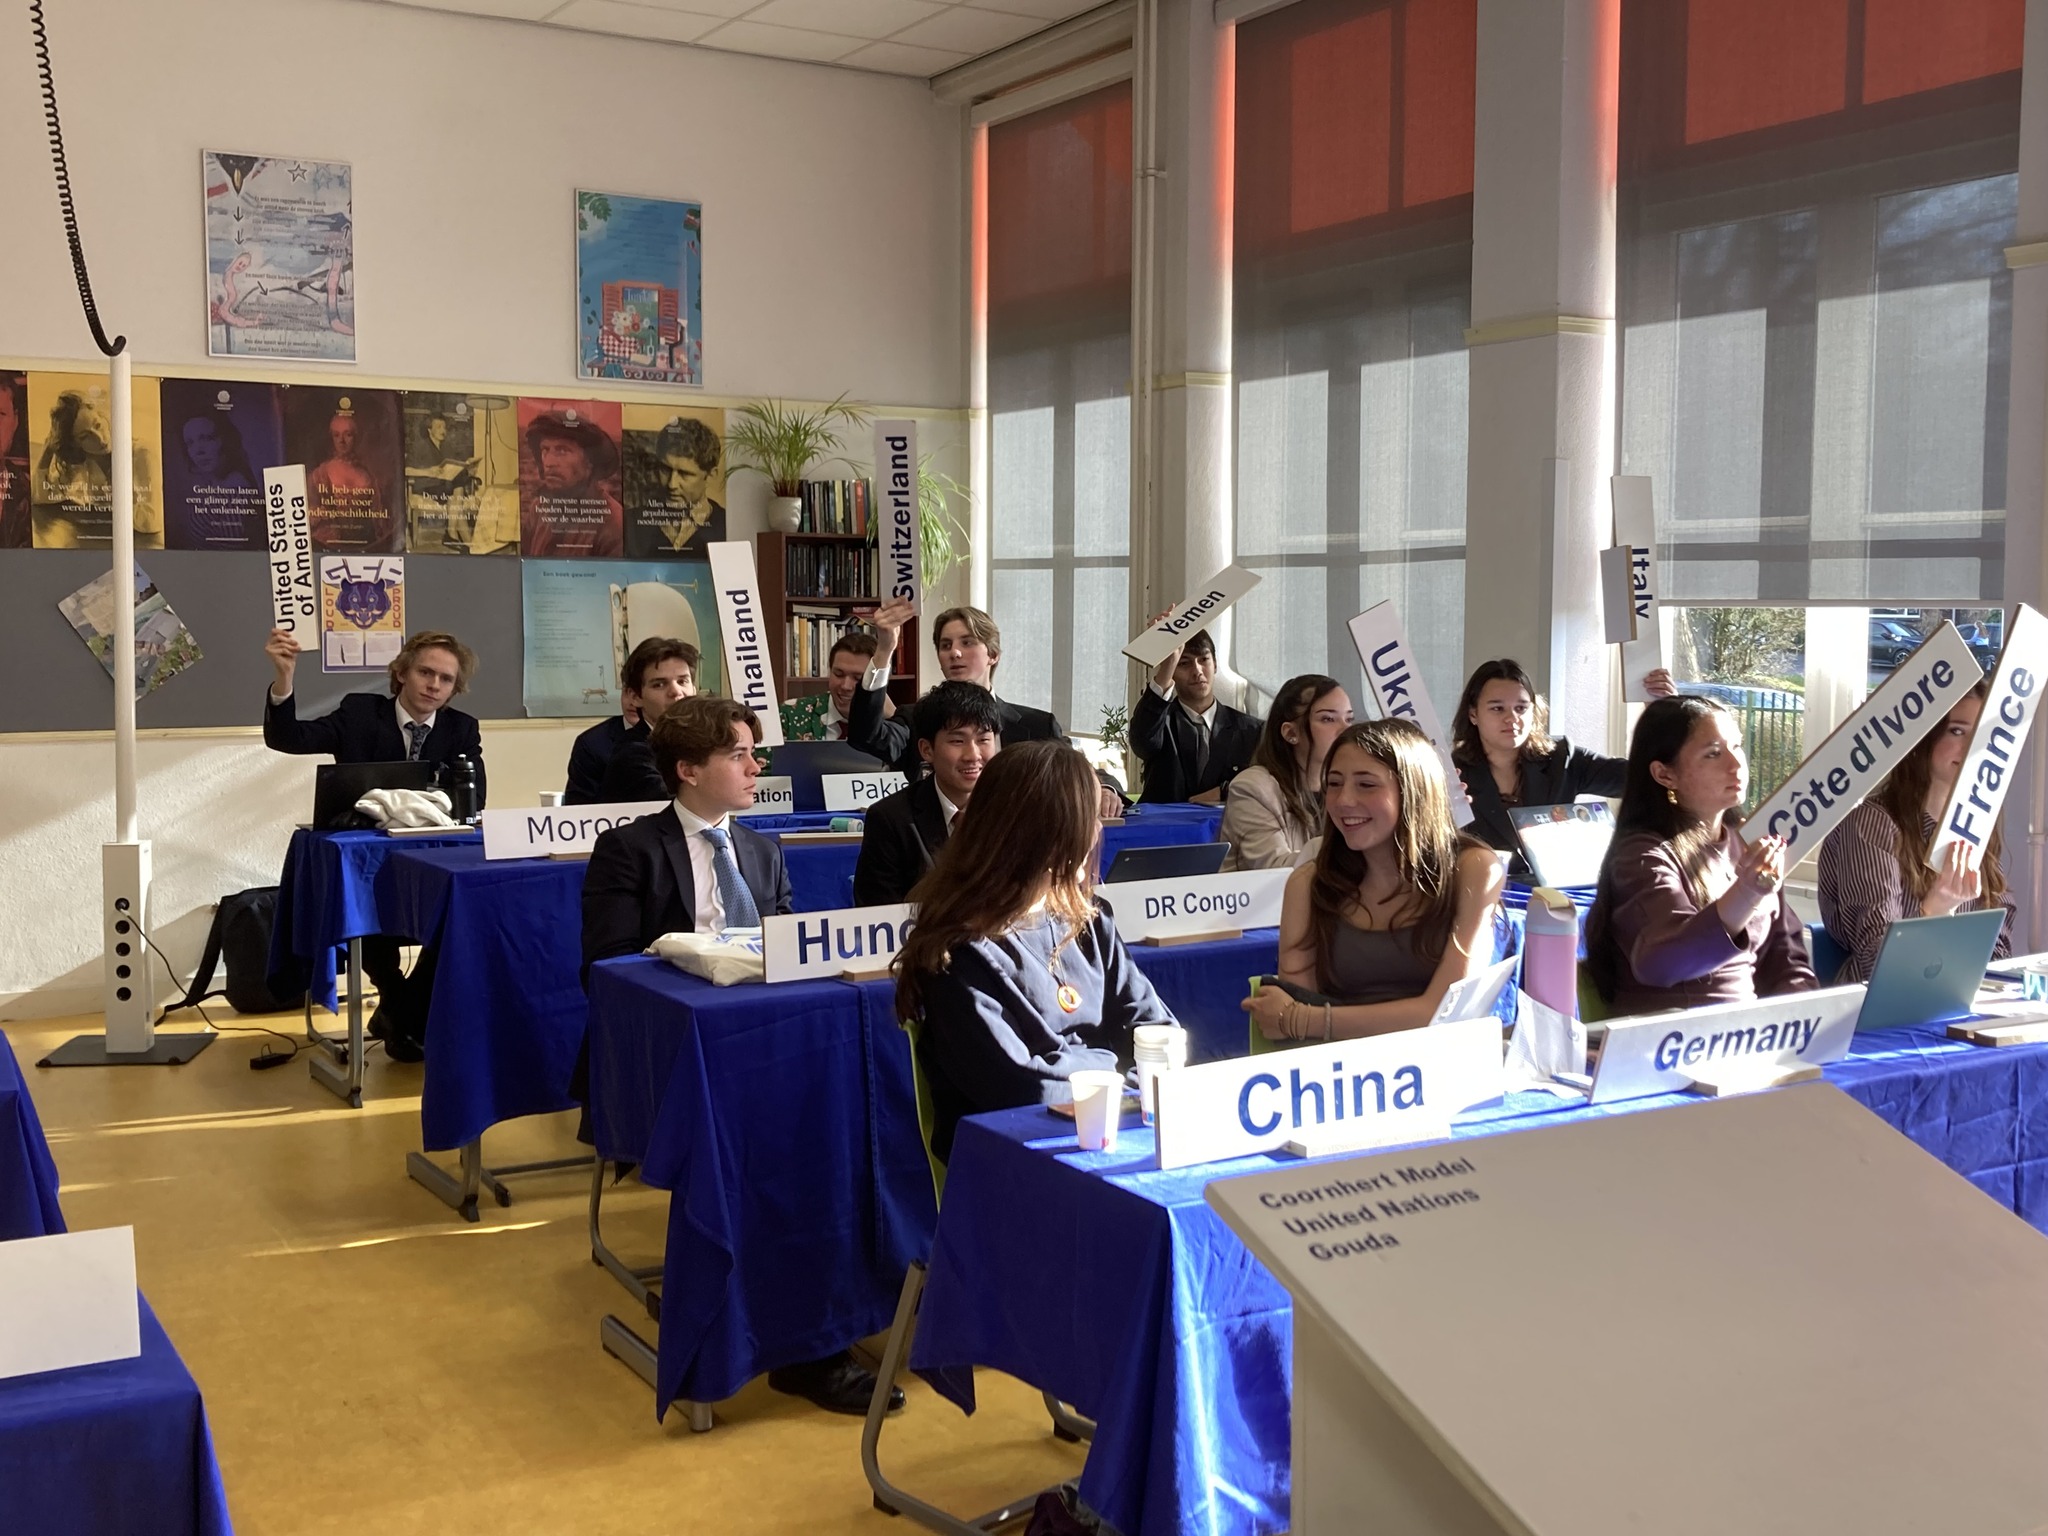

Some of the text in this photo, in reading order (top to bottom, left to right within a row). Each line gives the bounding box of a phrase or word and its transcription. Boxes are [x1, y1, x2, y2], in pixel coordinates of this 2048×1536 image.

[61, 502, 113, 512] wereld vert
[186, 496, 202, 504] een
[204, 495, 229, 506] glimp
[231, 496, 248, 505] zien
[192, 484, 259, 495] Gedichten laten
[194, 504, 208, 514] het
[318, 483, 375, 496] Ik heb geen
[321, 496, 348, 506] talent
[535, 505, 562, 514] houden
[564, 505, 579, 514] hun
[539, 495, 607, 506] De meeste mensen
[308, 506, 391, 519] ndergeschiktheid.
[560, 514, 569, 523] de
[885, 436, 914, 602] Switzerland
[269, 483, 296, 632] United States
[289, 496, 315, 616] of America
[325, 588, 334, 628] LOUD
[392, 588, 401, 628] PROUD
[1157, 590, 1226, 636] Yemen
[726, 589, 768, 713] Thailand
[1371, 640, 1436, 746] Ukr
[1767, 659, 1955, 847] Côte d'Ivore
[1948, 667, 2035, 847] France
[752, 787, 792, 804] ation
[1145, 891, 1251, 919] DR Congo
[1653, 1016, 1823, 1072] Germany
[1238, 1060, 1425, 1137] China
[1258, 1156, 1477, 1211] Coornhert Model
[1282, 1187, 1481, 1237] United Nations
[1308, 1232, 1401, 1262] Gouda
